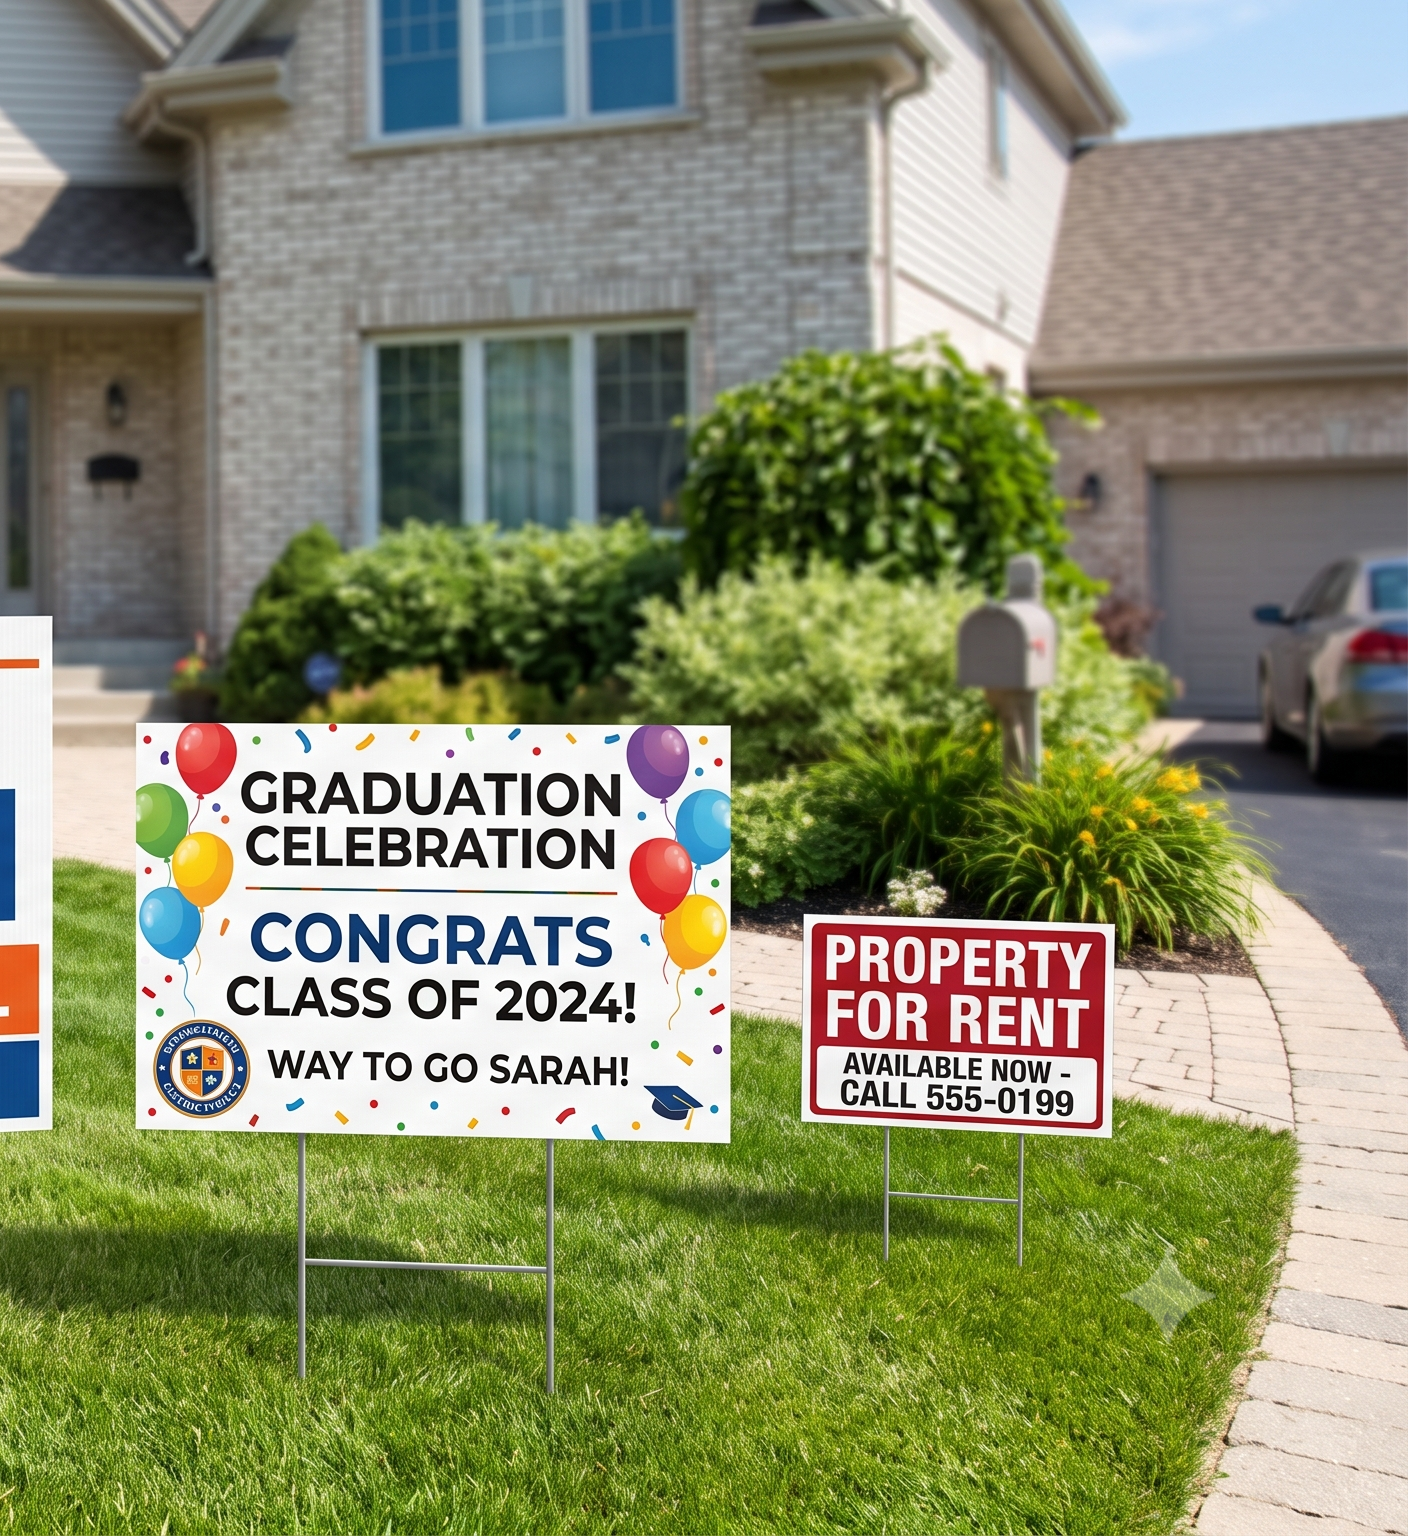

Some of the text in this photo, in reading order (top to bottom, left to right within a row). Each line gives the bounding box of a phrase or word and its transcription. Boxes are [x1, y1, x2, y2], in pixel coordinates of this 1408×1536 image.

[240, 770, 621, 817] GRADUATION
[245, 826, 616, 870] CELEBRATION
[250, 912, 613, 968] CONGRATS
[825, 934, 1093, 990] PROPERTY
[226, 975, 637, 1024] CLASS OF 2024!
[826, 989, 1090, 1049] FOR RENT
[267, 1049, 629, 1087] WAY TO GO SARAH!
[843, 1052, 982, 1081] AVAILABLE
[992, 1059, 1052, 1084] NOW
[840, 1079, 1074, 1117] CALL 555-0199
